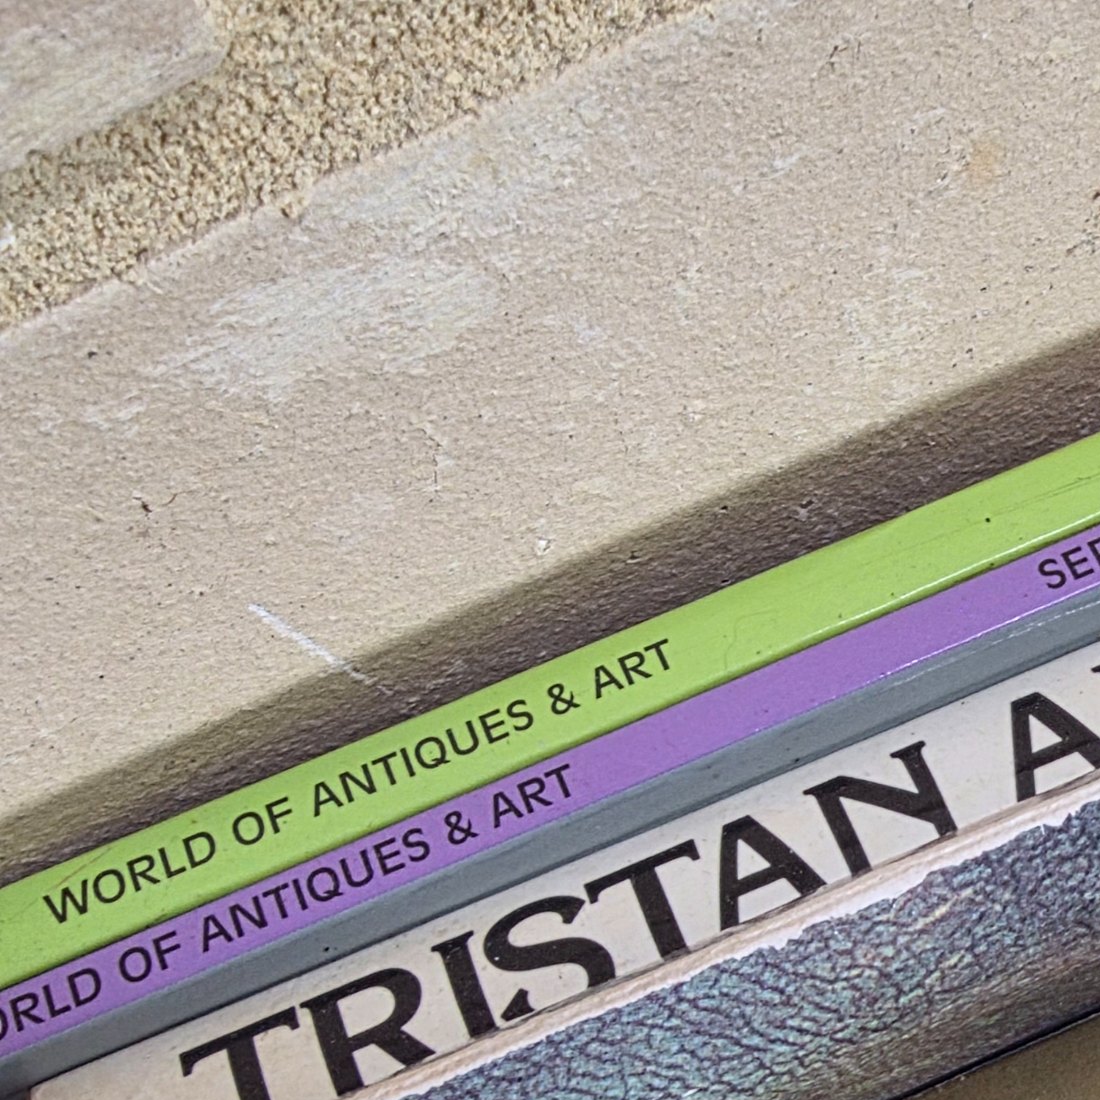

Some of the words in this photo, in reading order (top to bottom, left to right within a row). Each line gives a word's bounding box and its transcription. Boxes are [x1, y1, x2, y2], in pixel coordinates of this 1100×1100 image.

[0, 968, 101, 1040] RLD
[118, 932, 182, 985] OF
[200, 828, 432, 954] ANTIQUES
[445, 811, 479, 844] &
[491, 763, 574, 829] ART
[42, 831, 216, 924] WORLD
[232, 798, 294, 845] OF
[312, 701, 534, 817] ANTIQUES
[547, 683, 581, 716] &
[592, 638, 672, 699] ART
